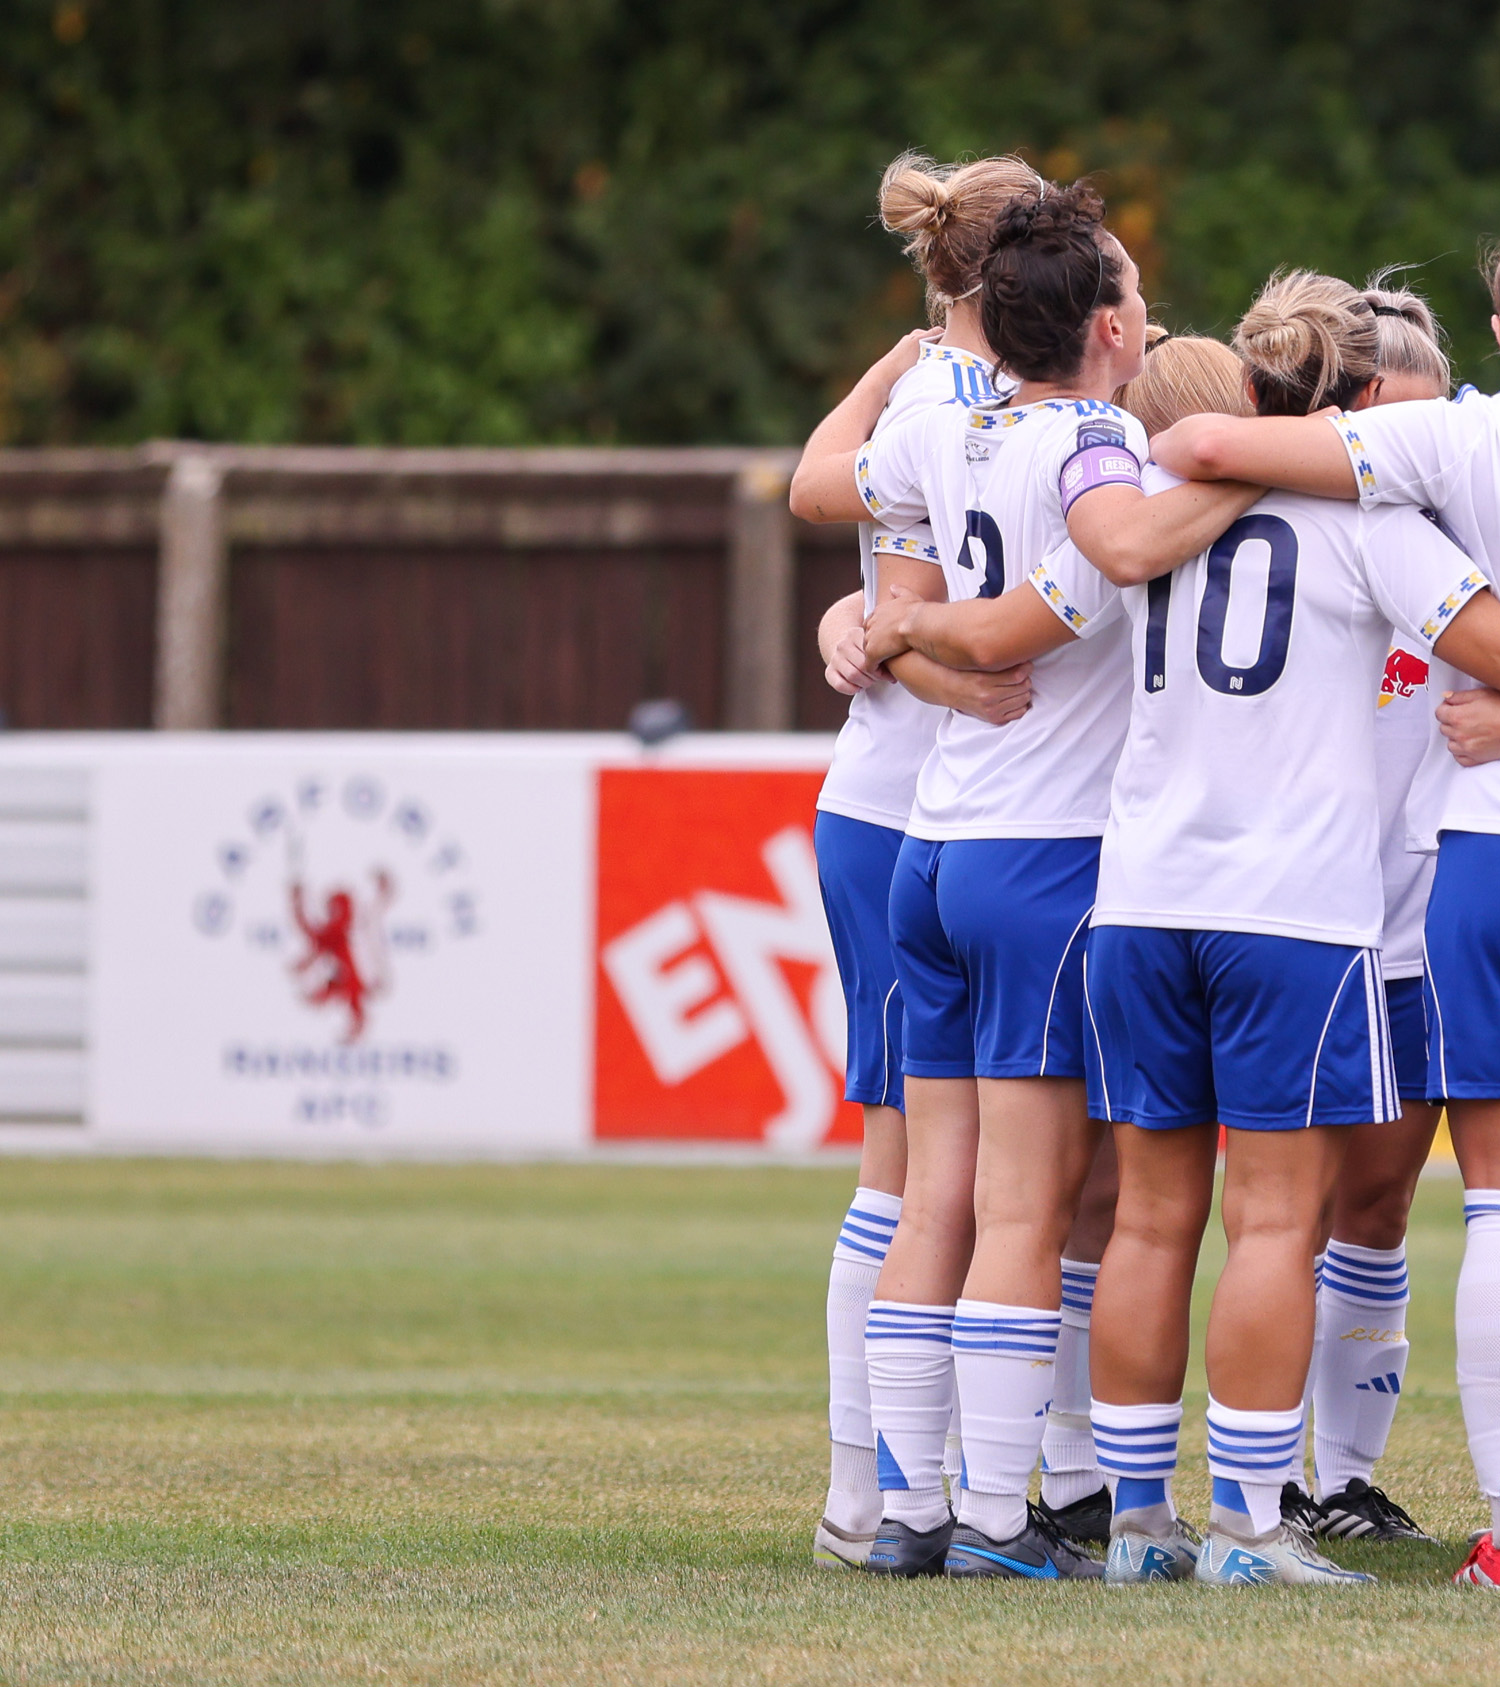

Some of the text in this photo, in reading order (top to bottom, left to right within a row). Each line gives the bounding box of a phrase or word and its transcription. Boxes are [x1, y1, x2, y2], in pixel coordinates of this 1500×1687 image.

[1144, 512, 1299, 697] 10
[222, 1041, 458, 1085] RANGERS
[294, 1091, 391, 1130] AFC
